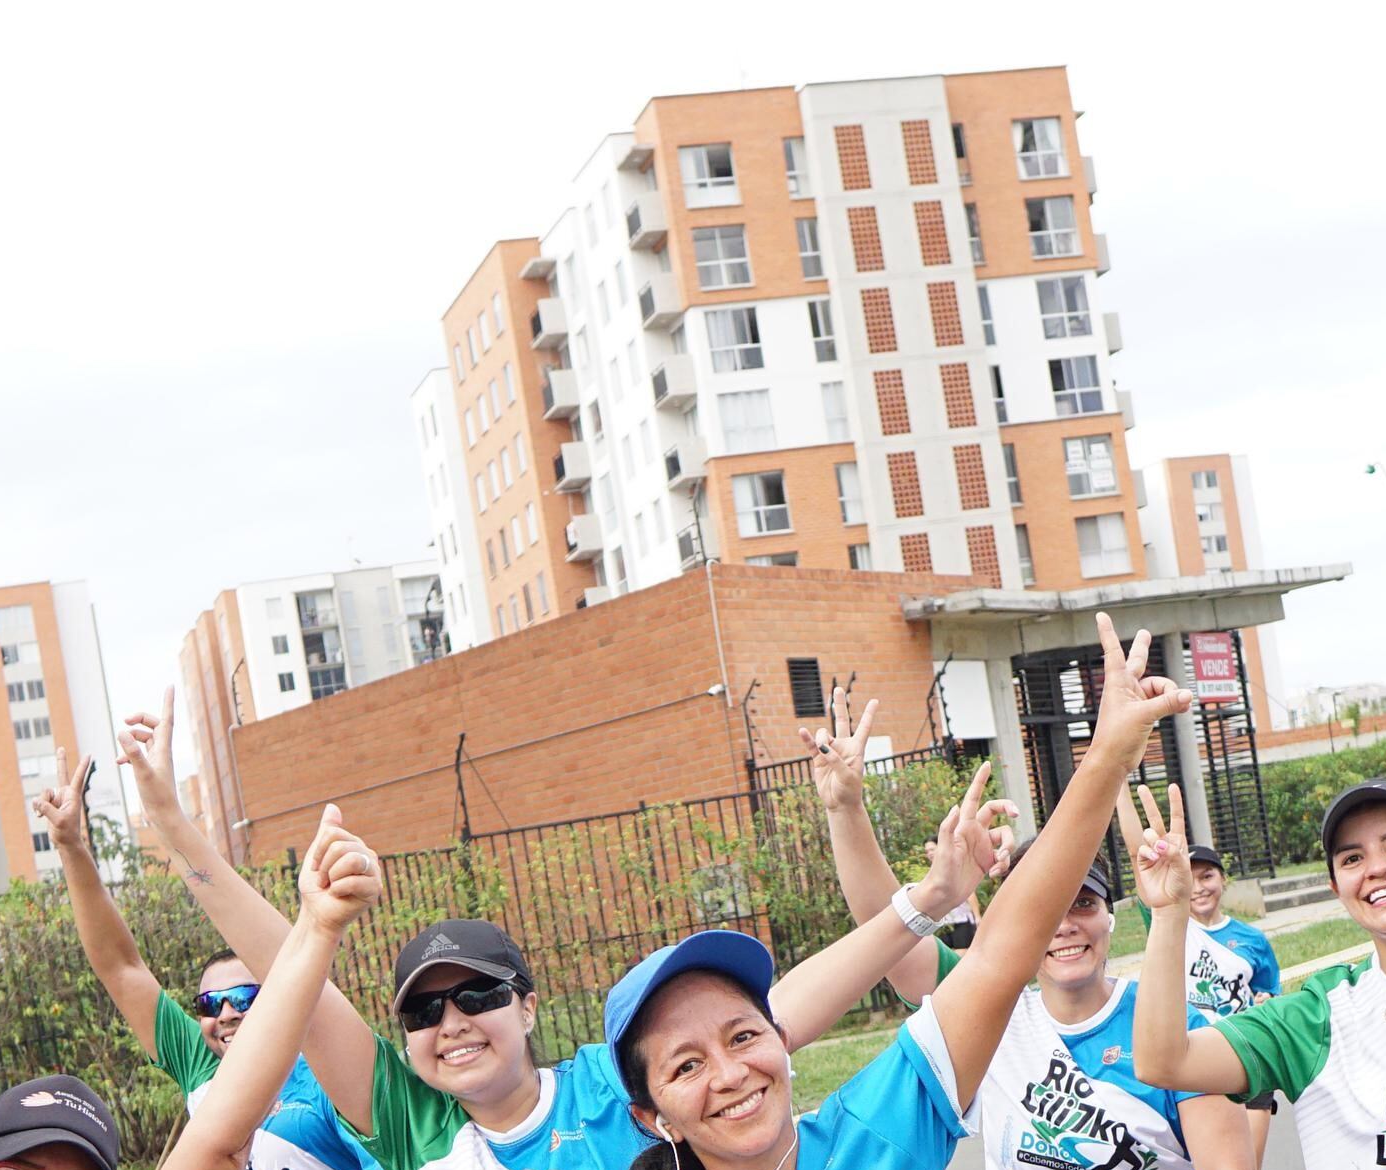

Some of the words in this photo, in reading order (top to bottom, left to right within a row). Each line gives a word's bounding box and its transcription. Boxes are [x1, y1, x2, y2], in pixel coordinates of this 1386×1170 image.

[1200, 659, 1229, 677] VENDE
[1042, 1058, 1095, 1099] Río
[64, 1098, 77, 1109] Tu
